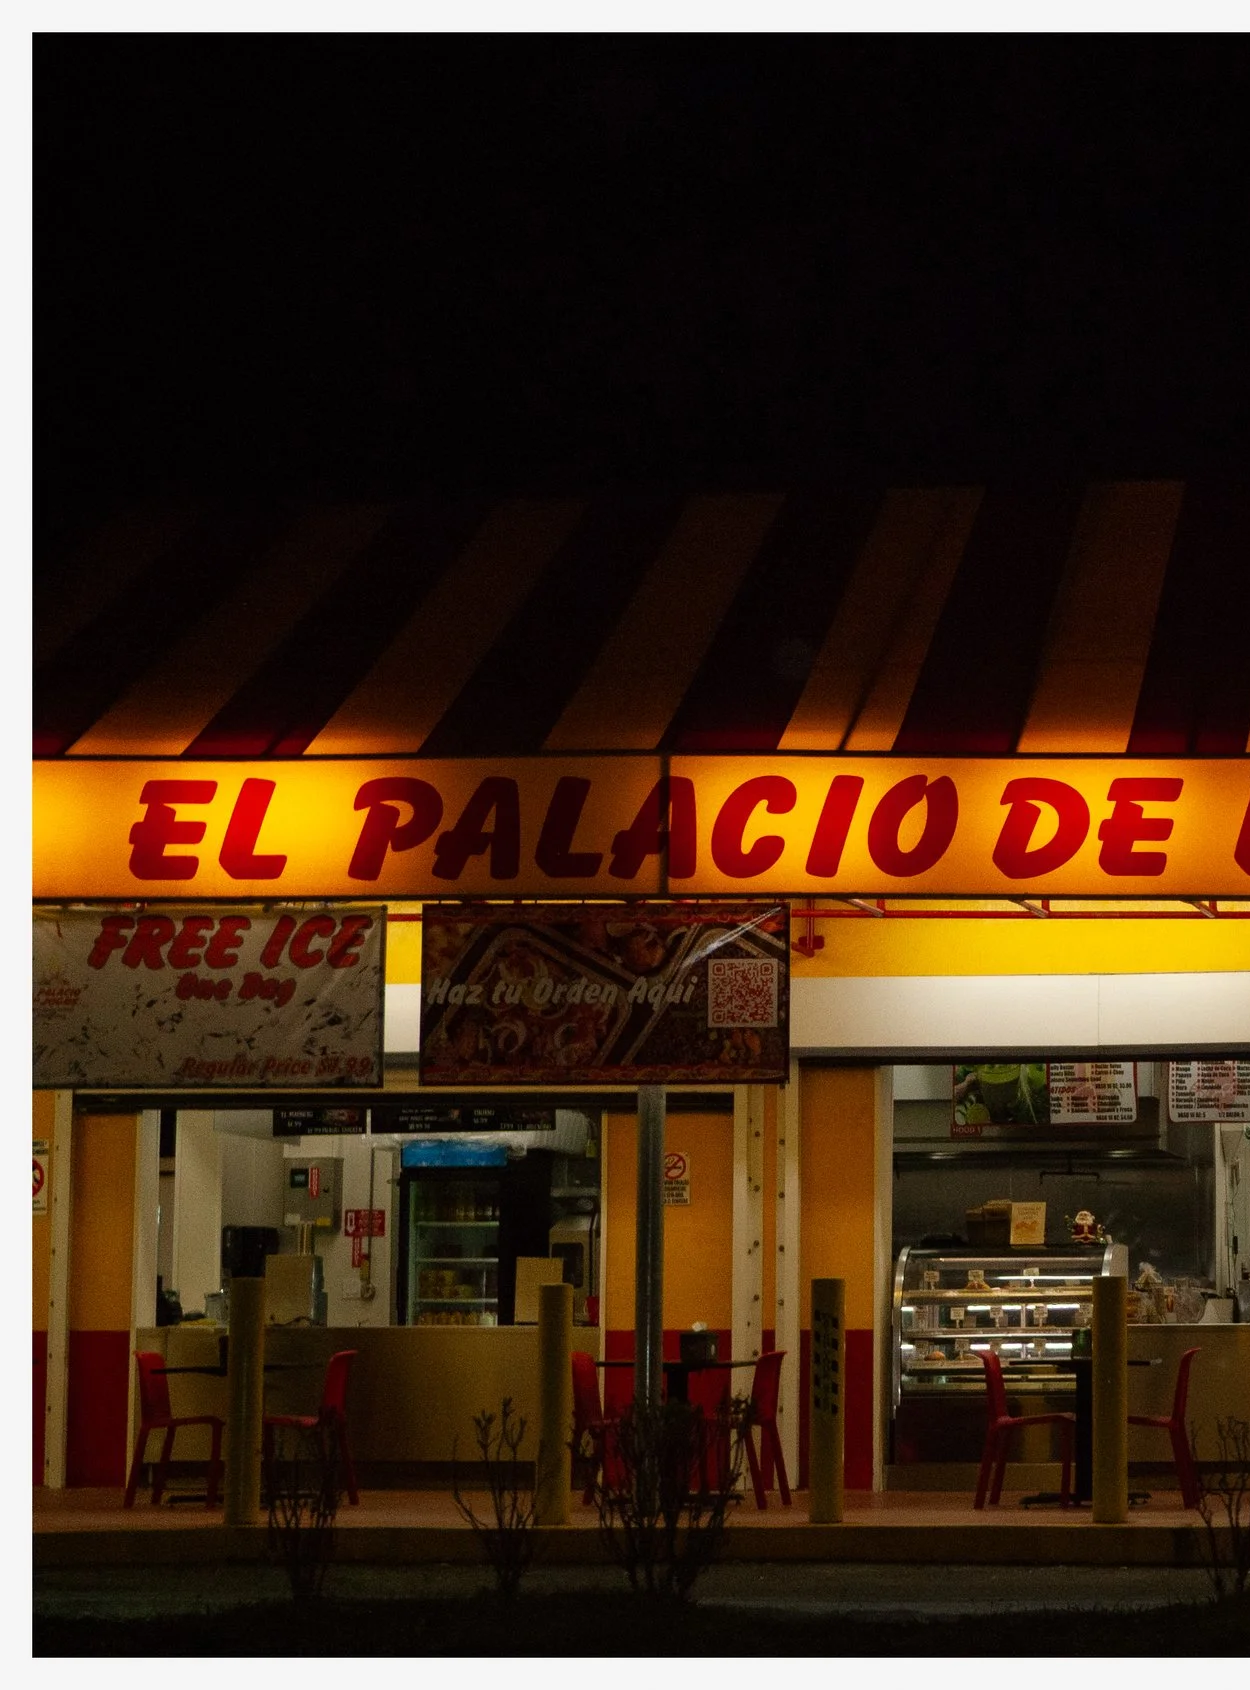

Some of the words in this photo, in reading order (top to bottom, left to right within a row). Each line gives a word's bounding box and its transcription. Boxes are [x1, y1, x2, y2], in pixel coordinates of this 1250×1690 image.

[129, 778, 288, 881] EL
[347, 774, 960, 881] PALACIO
[991, 777, 1184, 881] DE
[87, 915, 251, 970] FREE
[260, 915, 374, 969] ICE
[427, 978, 482, 1005] Haz
[492, 979, 523, 1004] tu
[534, 978, 620, 1004] Orden
[182, 1056, 254, 1080] Regular
[263, 1057, 312, 1078] Price
